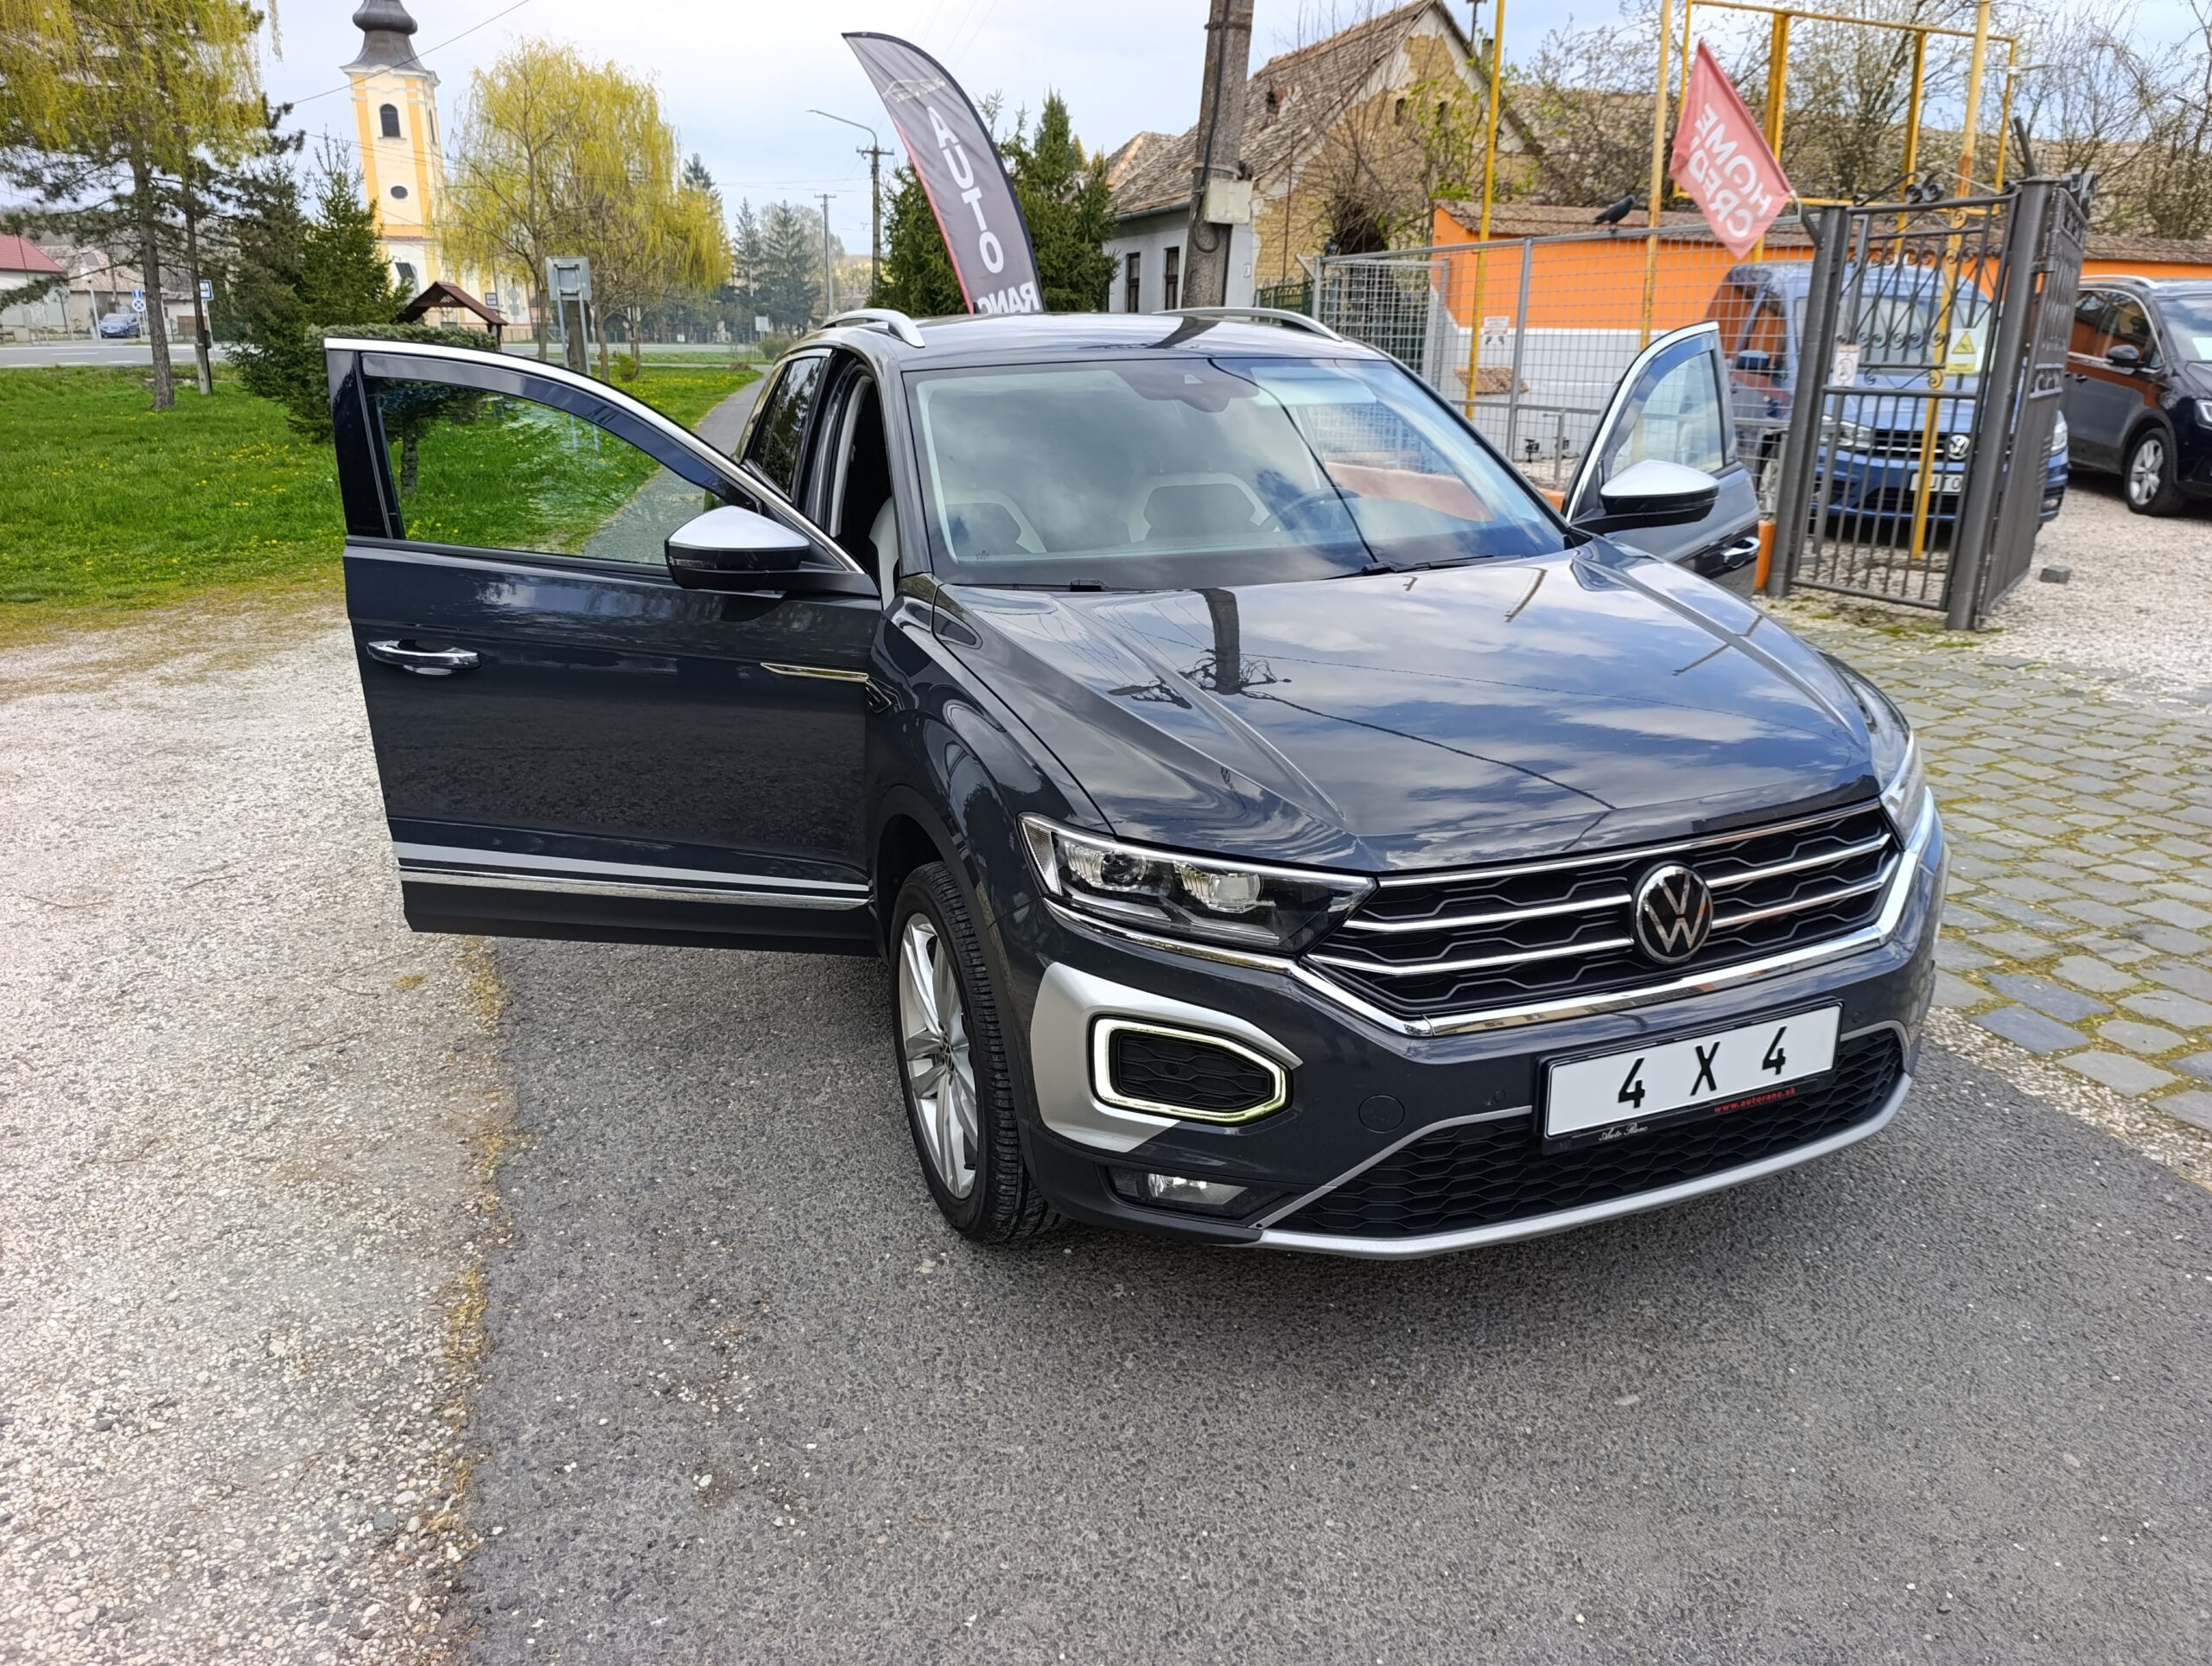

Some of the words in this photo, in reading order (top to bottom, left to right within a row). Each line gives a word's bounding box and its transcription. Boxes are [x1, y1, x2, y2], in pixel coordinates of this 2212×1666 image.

[1639, 867, 1709, 955] VW
[1618, 1057, 1645, 1109] 4
[1690, 1041, 1720, 1096] X
[1761, 1026, 1787, 1075] 4
[1713, 1087, 1796, 1113] www.autoranc.sk
